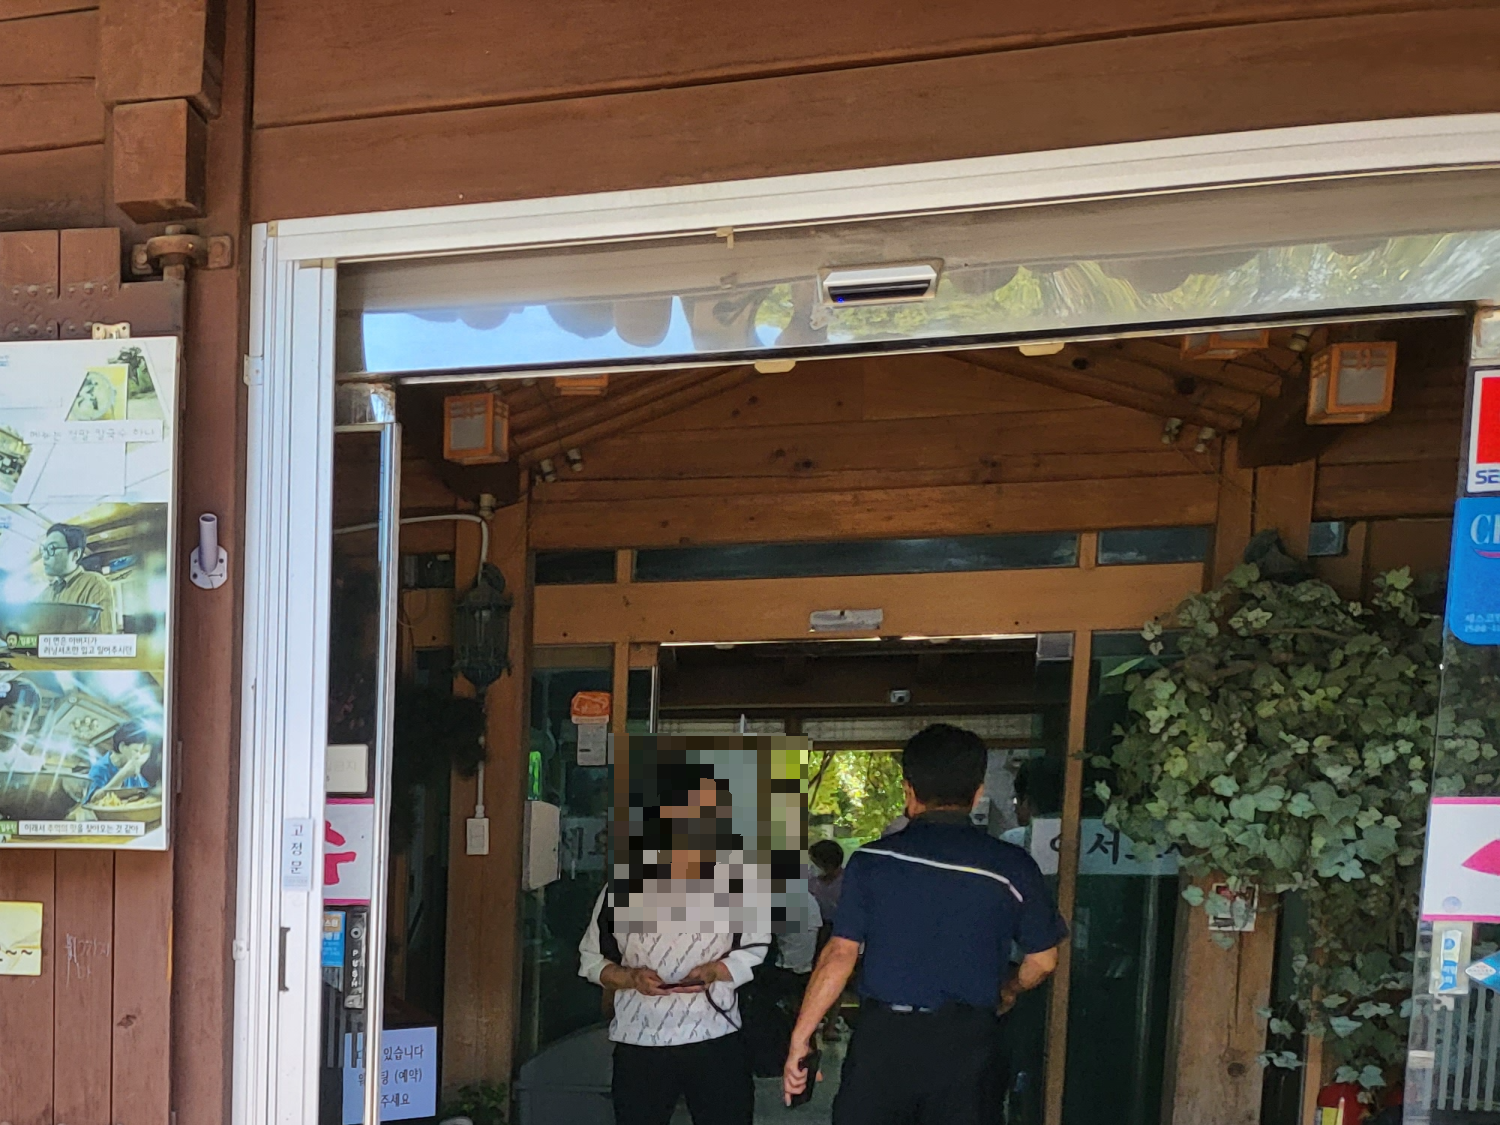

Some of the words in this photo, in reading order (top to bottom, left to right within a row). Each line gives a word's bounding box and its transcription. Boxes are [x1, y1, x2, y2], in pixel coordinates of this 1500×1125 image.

[383, 1044, 424, 1062] 있습니다
[394, 1067, 423, 1085] (예약)
[380, 1092, 411, 1109] 주세요
